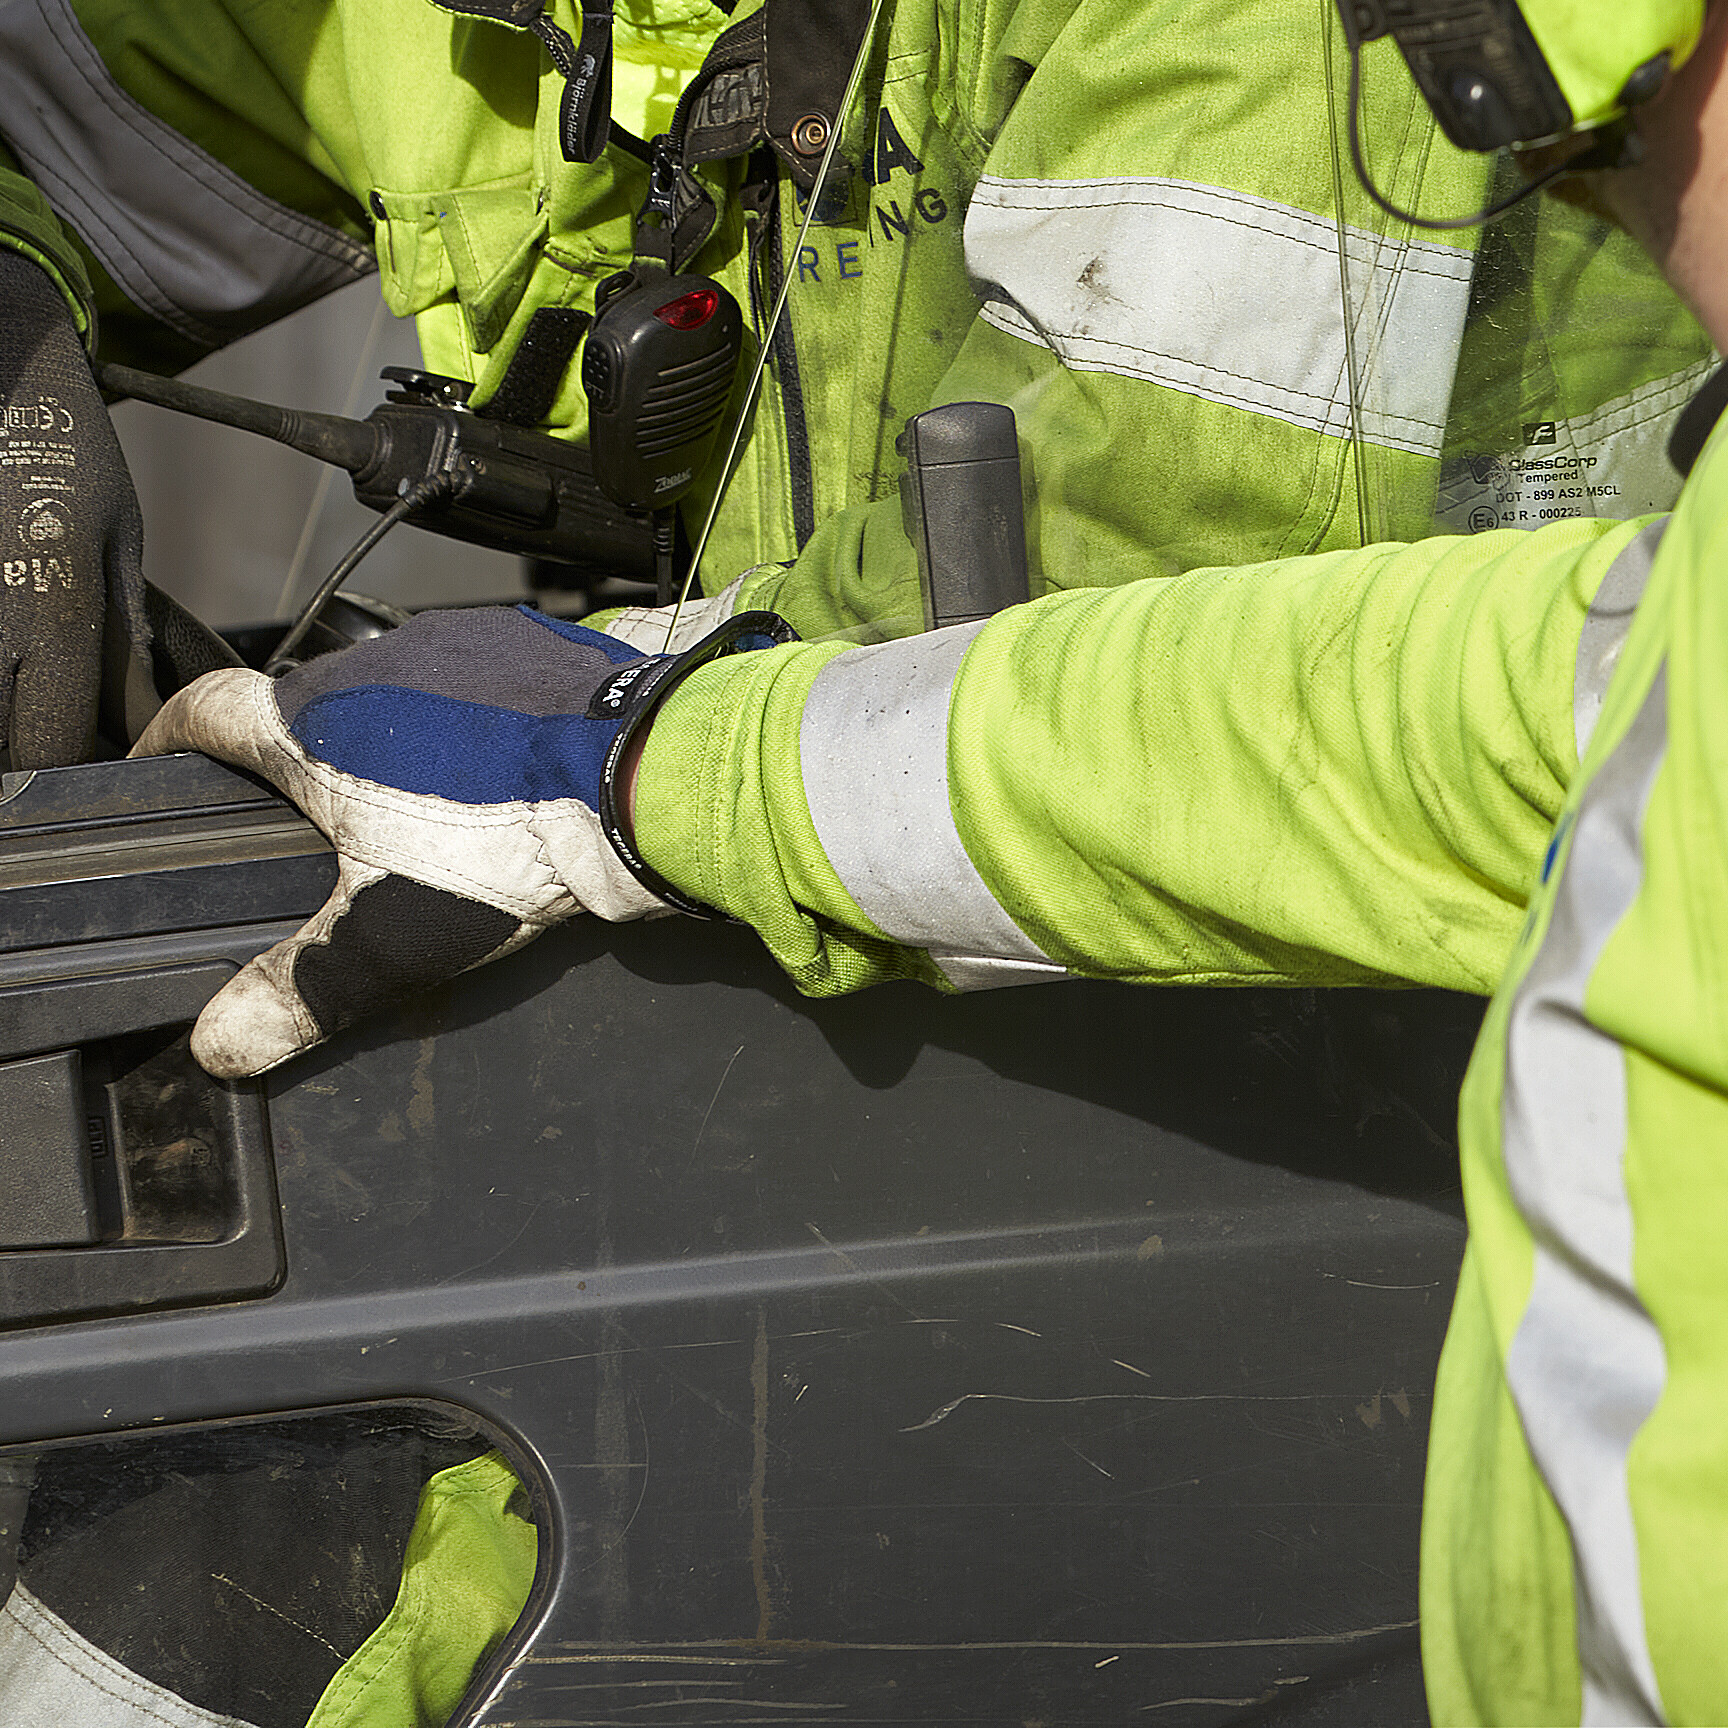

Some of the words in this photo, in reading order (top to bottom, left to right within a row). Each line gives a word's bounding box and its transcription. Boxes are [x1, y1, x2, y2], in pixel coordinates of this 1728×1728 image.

[566, 76, 588, 156] Björnkläder
[1508, 456, 1598, 471] GlassCorp
[1518, 470, 1579, 484] Tempered
[1496, 491, 1523, 503] DOT
[1533, 489, 1555, 501] 899
[1558, 487, 1583, 499] AS2
[1586, 485, 1621, 498] M5CL
[1501, 510, 1516, 522] 43
[1519, 510, 1529, 521] R
